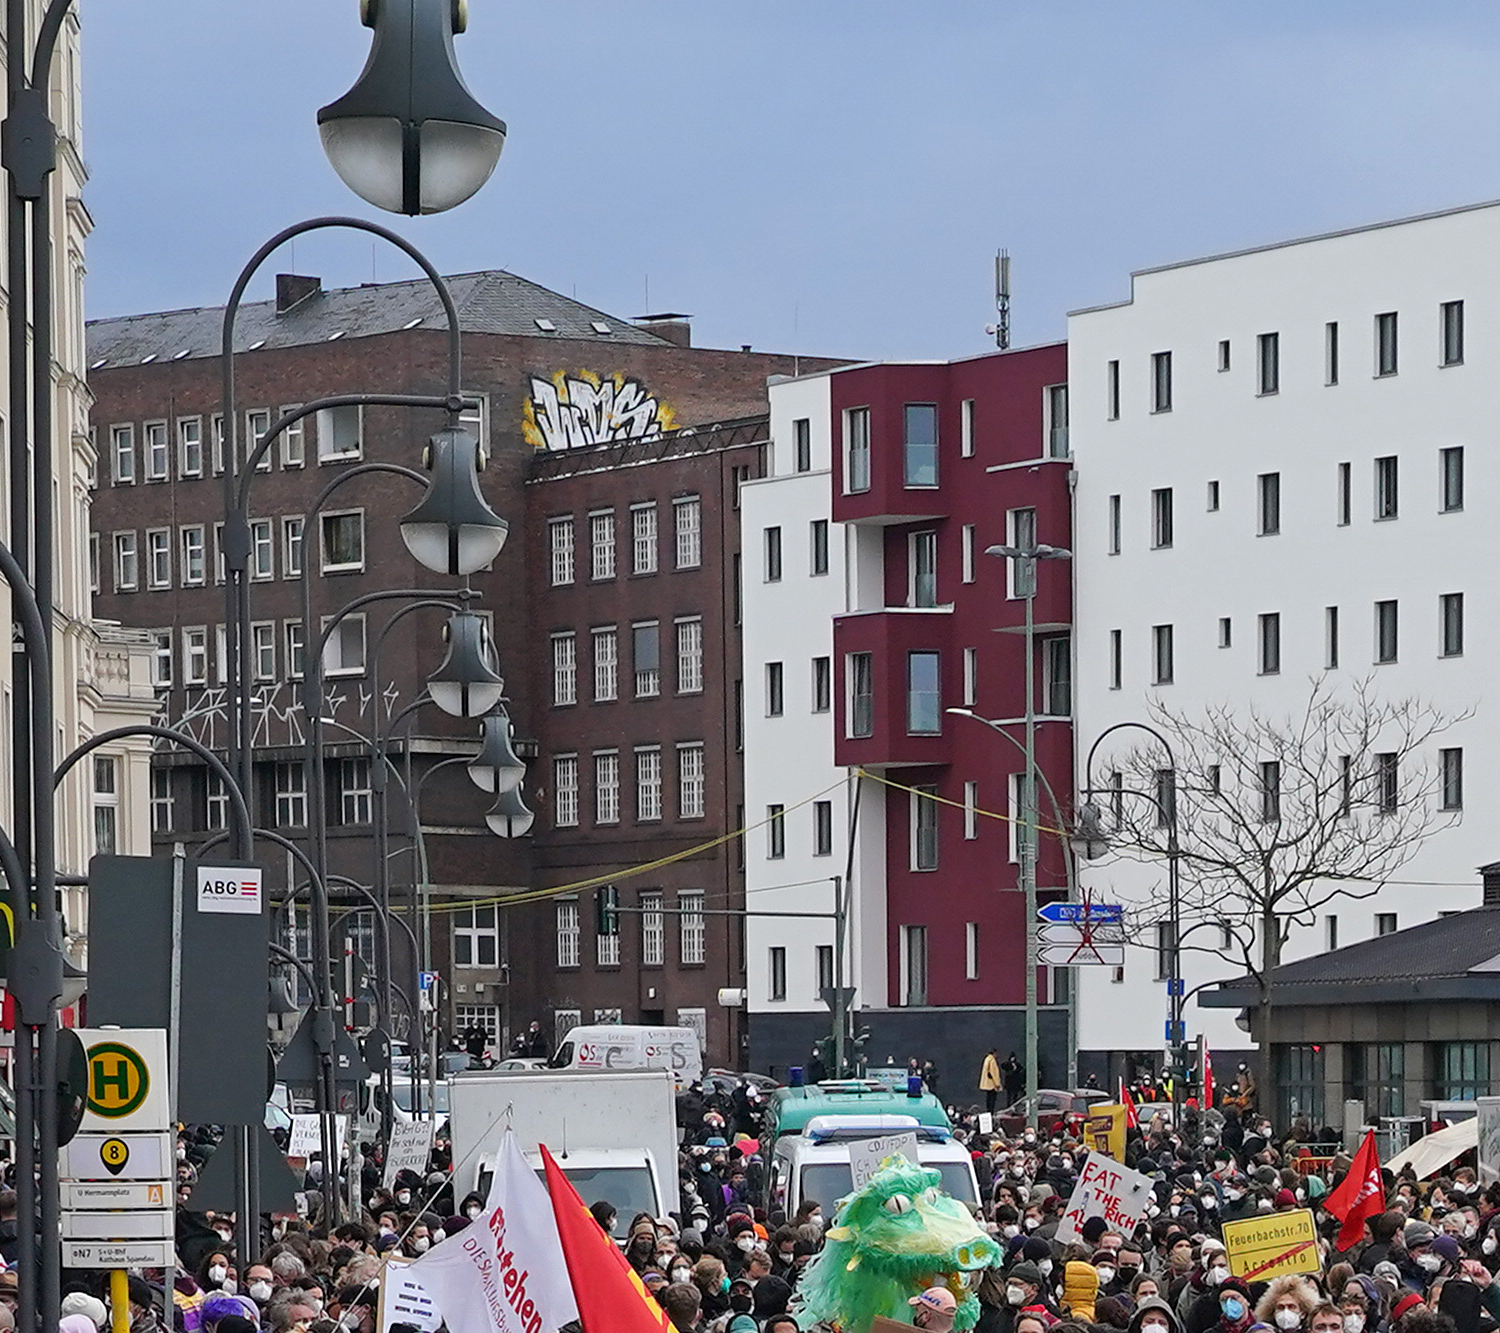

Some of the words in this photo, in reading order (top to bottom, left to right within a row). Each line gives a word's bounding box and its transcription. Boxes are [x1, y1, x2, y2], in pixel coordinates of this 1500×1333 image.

[202, 880, 237, 895] ABG
[94, 1062, 129, 1100] H
[109, 1145, 120, 1161] 8
[1083, 1162, 1122, 1191] EAT
[1094, 1186, 1122, 1206] THE
[1104, 1205, 1137, 1231] RICH
[80, 1249, 92, 1259] N7
